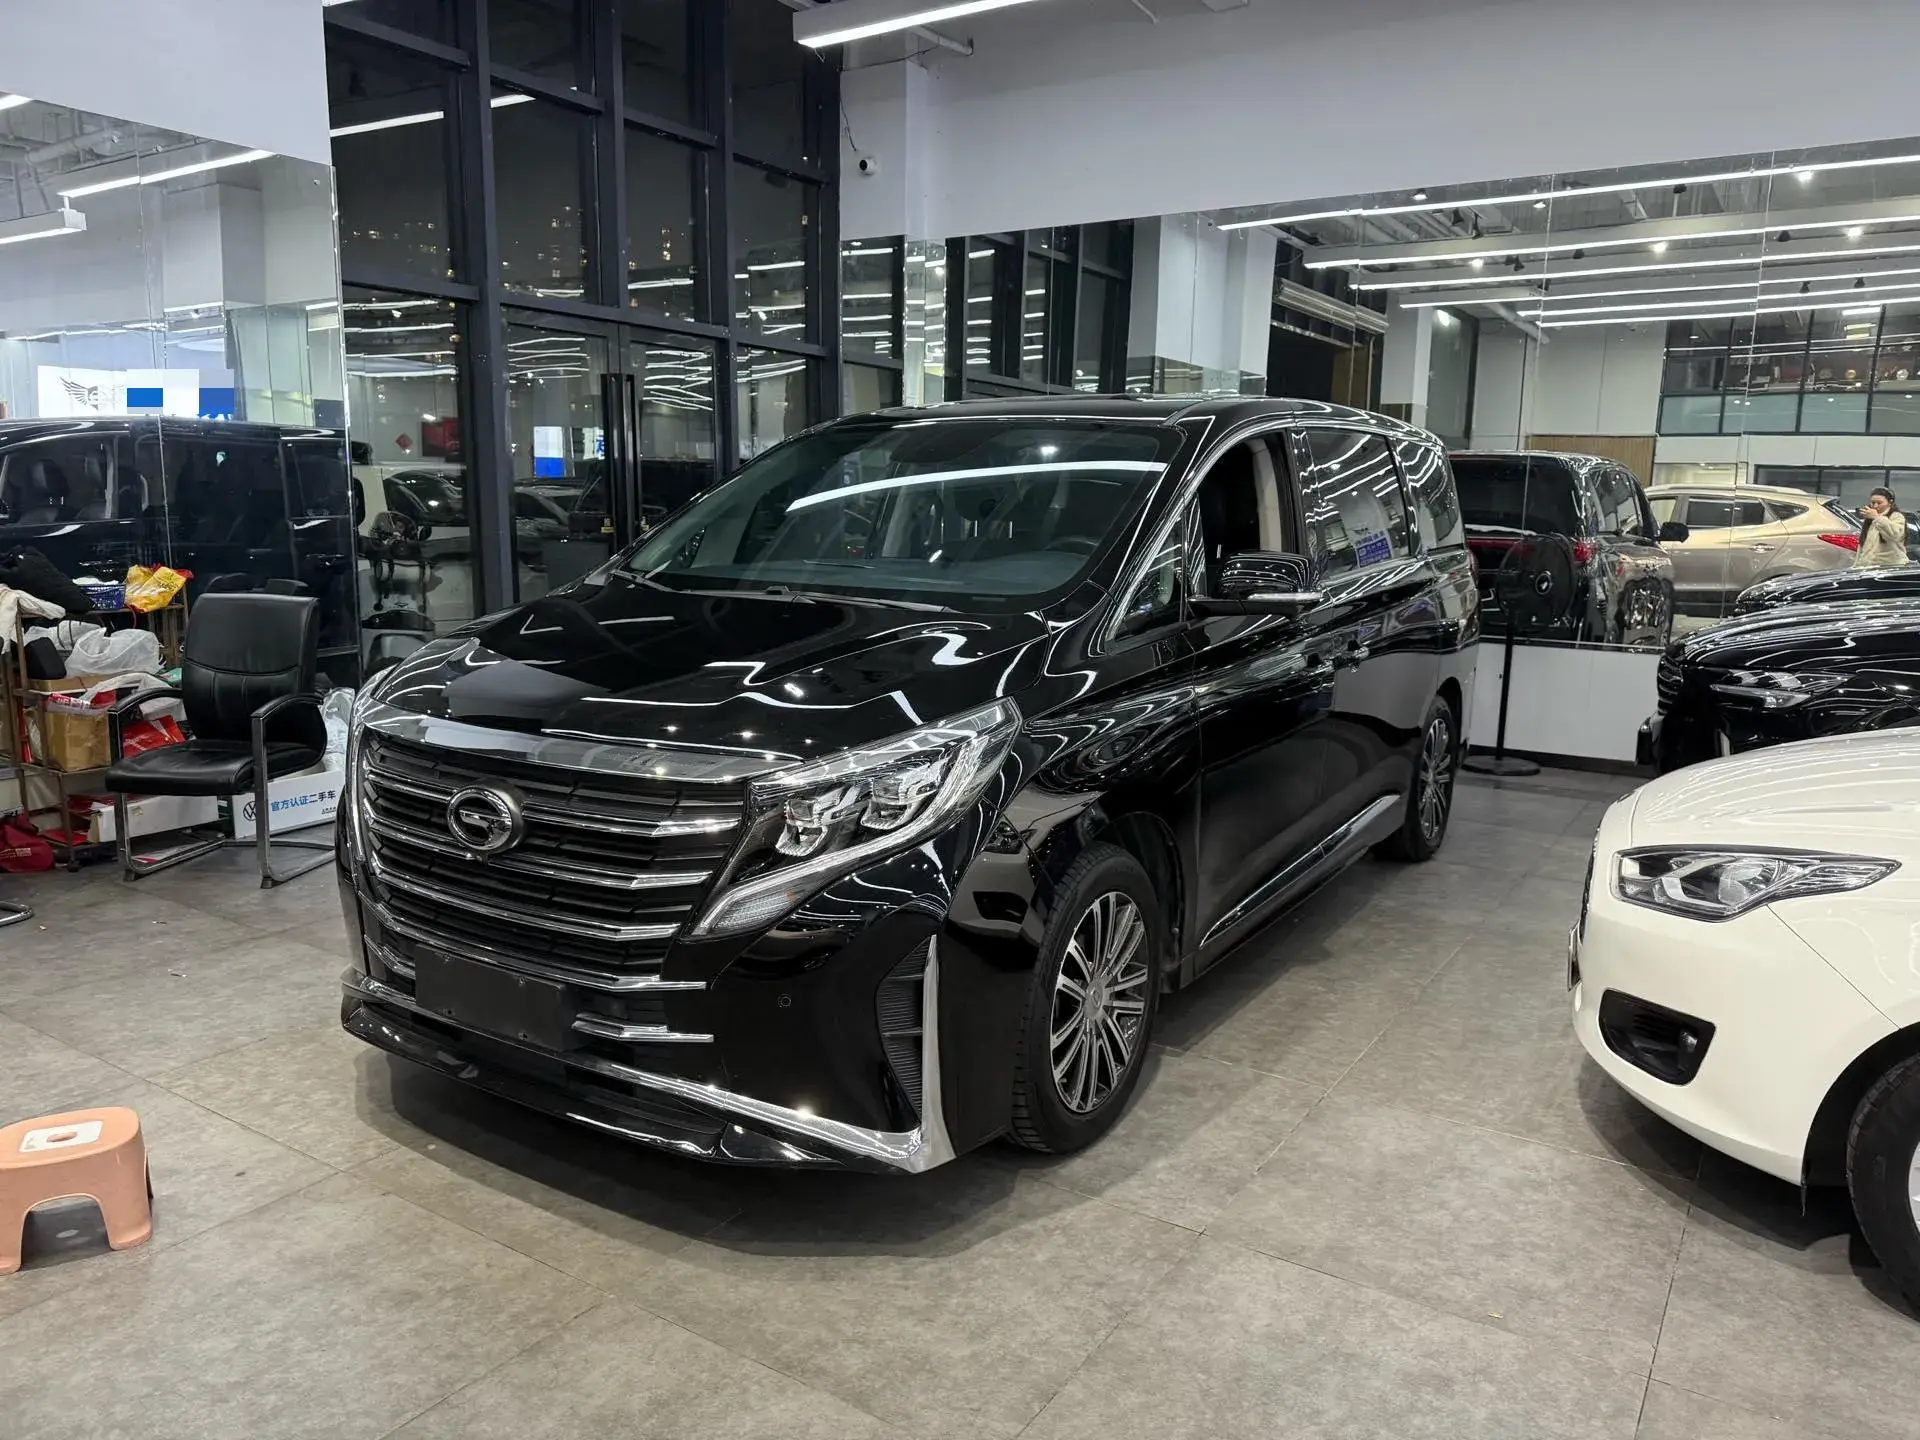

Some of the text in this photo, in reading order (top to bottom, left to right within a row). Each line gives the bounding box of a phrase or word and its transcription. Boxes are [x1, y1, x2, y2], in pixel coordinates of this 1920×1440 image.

[271, 790, 336, 812] 官方认证二手车
